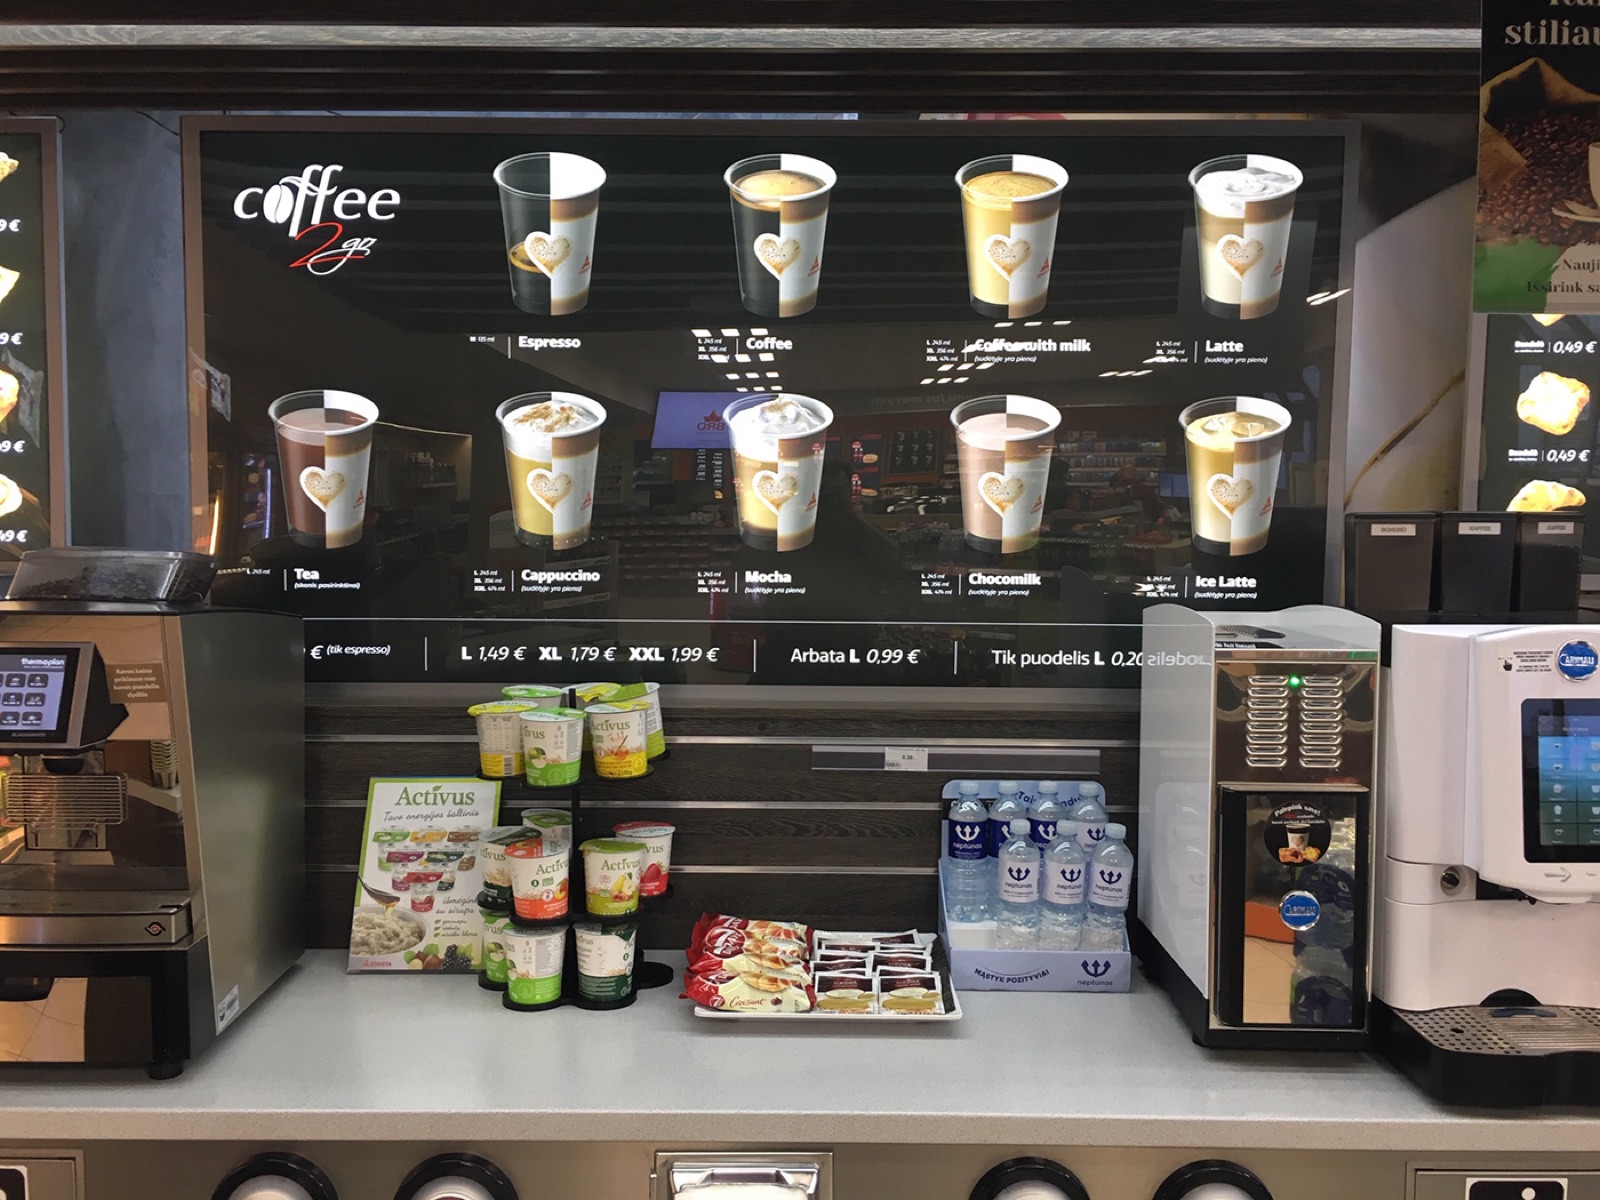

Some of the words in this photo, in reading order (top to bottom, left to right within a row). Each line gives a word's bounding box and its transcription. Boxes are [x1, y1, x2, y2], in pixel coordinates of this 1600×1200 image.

[234, 164, 400, 237] coffee
[9, 220, 21, 231] €
[10, 332, 23, 344] €
[518, 336, 581, 350] Espresso
[746, 337, 793, 350] Coffee
[1059, 338, 1091, 351] milk
[1206, 340, 1244, 352] Latte
[1553, 341, 1583, 354] 0,49
[1585, 341, 1597, 353] €
[14, 441, 25, 453] €
[1546, 450, 1576, 462] 0,49
[1578, 450, 1590, 462] €
[16, 530, 28, 543] €
[294, 568, 320, 580] Tea
[521, 569, 600, 583] Cappuccino
[745, 570, 792, 583] Mocha
[968, 573, 1042, 585] Chocomilk
[1195, 576, 1216, 587] Ice
[1218, 576, 1257, 587] Latte
[310, 645, 324, 659] €
[327, 644, 343, 655] (tik
[344, 644, 391, 656] espresso)
[461, 647, 472, 660] L
[478, 646, 509, 662] 1,49
[514, 646, 527, 660] €
[538, 647, 562, 660] XL
[570, 646, 599, 663] 1,79
[603, 647, 617, 661] €
[629, 647, 664, 661] XXL
[671, 647, 702, 663] 1,99
[706, 648, 719, 662] €
[790, 648, 846, 664] Arbata
[850, 649, 860, 663] L
[865, 648, 902, 665] 0,99
[907, 649, 920, 664] €
[992, 649, 1018, 665] Tik
[1021, 648, 1090, 668] puodelis
[1094, 650, 1105, 665] L
[394, 785, 475, 806] Activus
[600, 858, 641, 871] Activus
[974, 967, 1005, 983] MĄSTYK
[1006, 968, 1050, 984] POZITYVIAI
